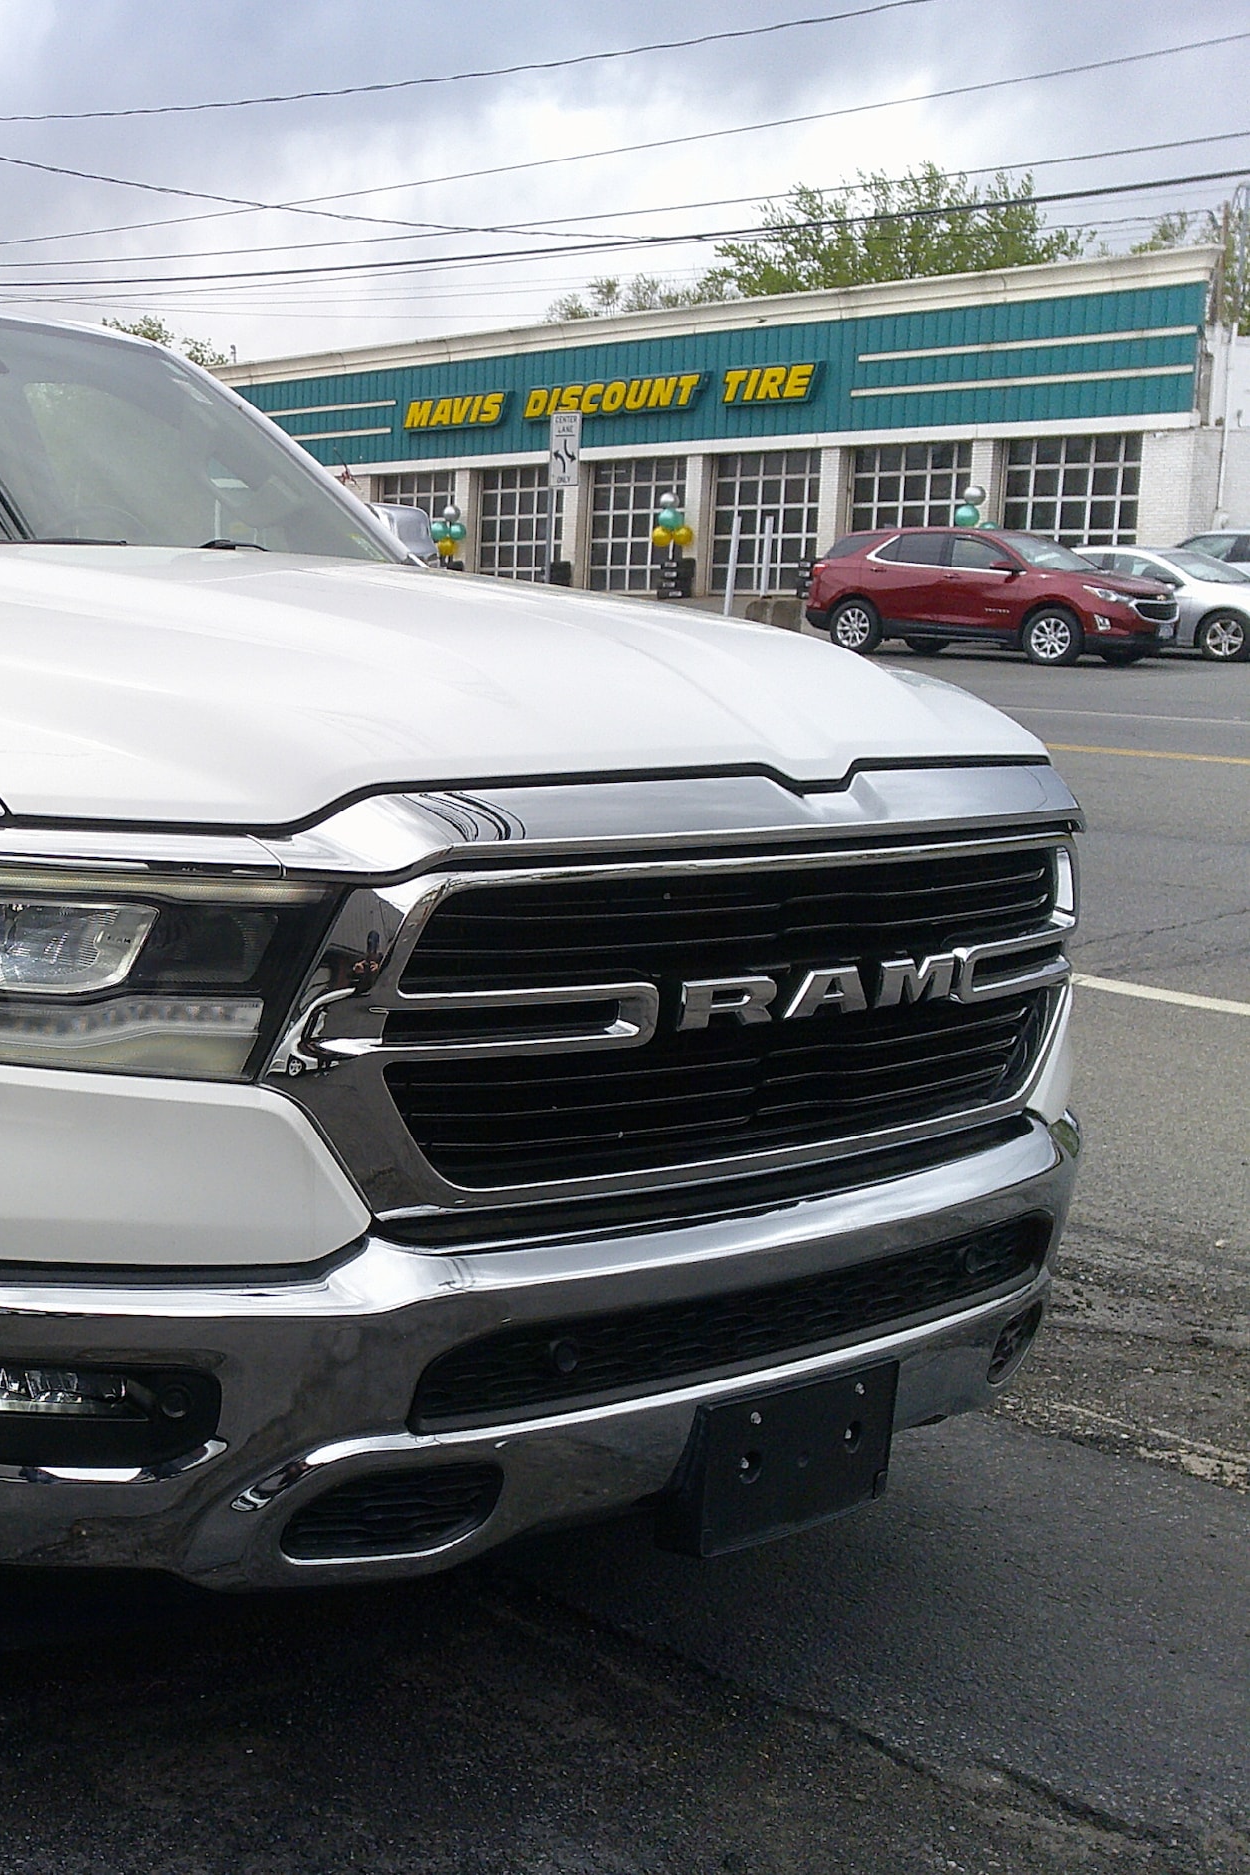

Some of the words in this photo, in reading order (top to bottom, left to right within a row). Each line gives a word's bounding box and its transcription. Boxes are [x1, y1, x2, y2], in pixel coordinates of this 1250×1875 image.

[404, 393, 504, 429] MAVIS
[523, 374, 700, 418] DISCOUNT
[723, 364, 814, 402] TIRE
[555, 415, 578, 424] CENTER
[558, 425, 573, 433] LANE
[557, 475, 570, 484] ONLY
[676, 953, 955, 1031] RAM
